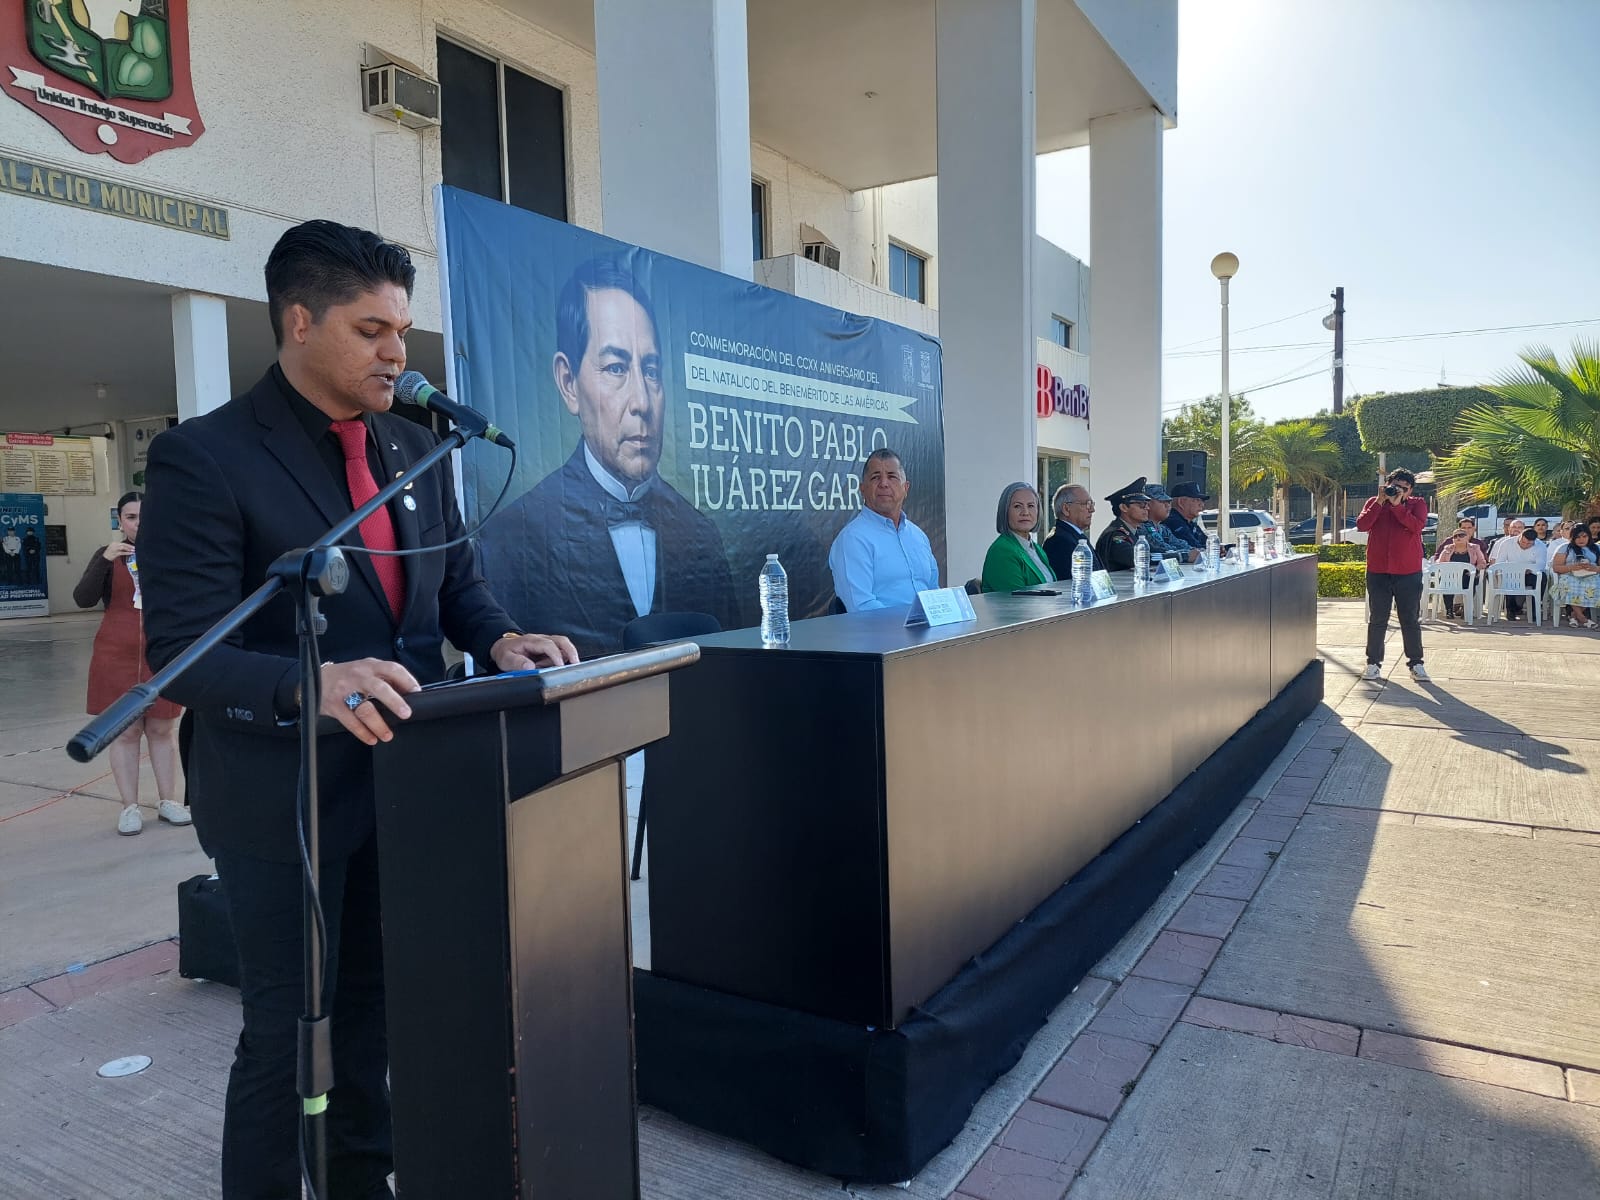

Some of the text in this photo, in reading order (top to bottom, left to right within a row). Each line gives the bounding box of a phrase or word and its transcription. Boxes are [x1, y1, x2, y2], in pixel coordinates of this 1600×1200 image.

[38, 87, 174, 136] Unidad Trabajo Superación
[100, 184, 229, 236] MUNICIPAL
[690, 331, 880, 384] CONMEMORACIÓN DEL CCXX ANIVERSARIO DEL
[691, 365, 889, 411] DEL NATALICIO DEL BENEMÉRITO DE LAS AMÉRICAS
[1053, 376, 1090, 420] BanB
[687, 401, 888, 463] BENITO PABLO
[690, 455, 865, 511] JUÁREZ GAR
